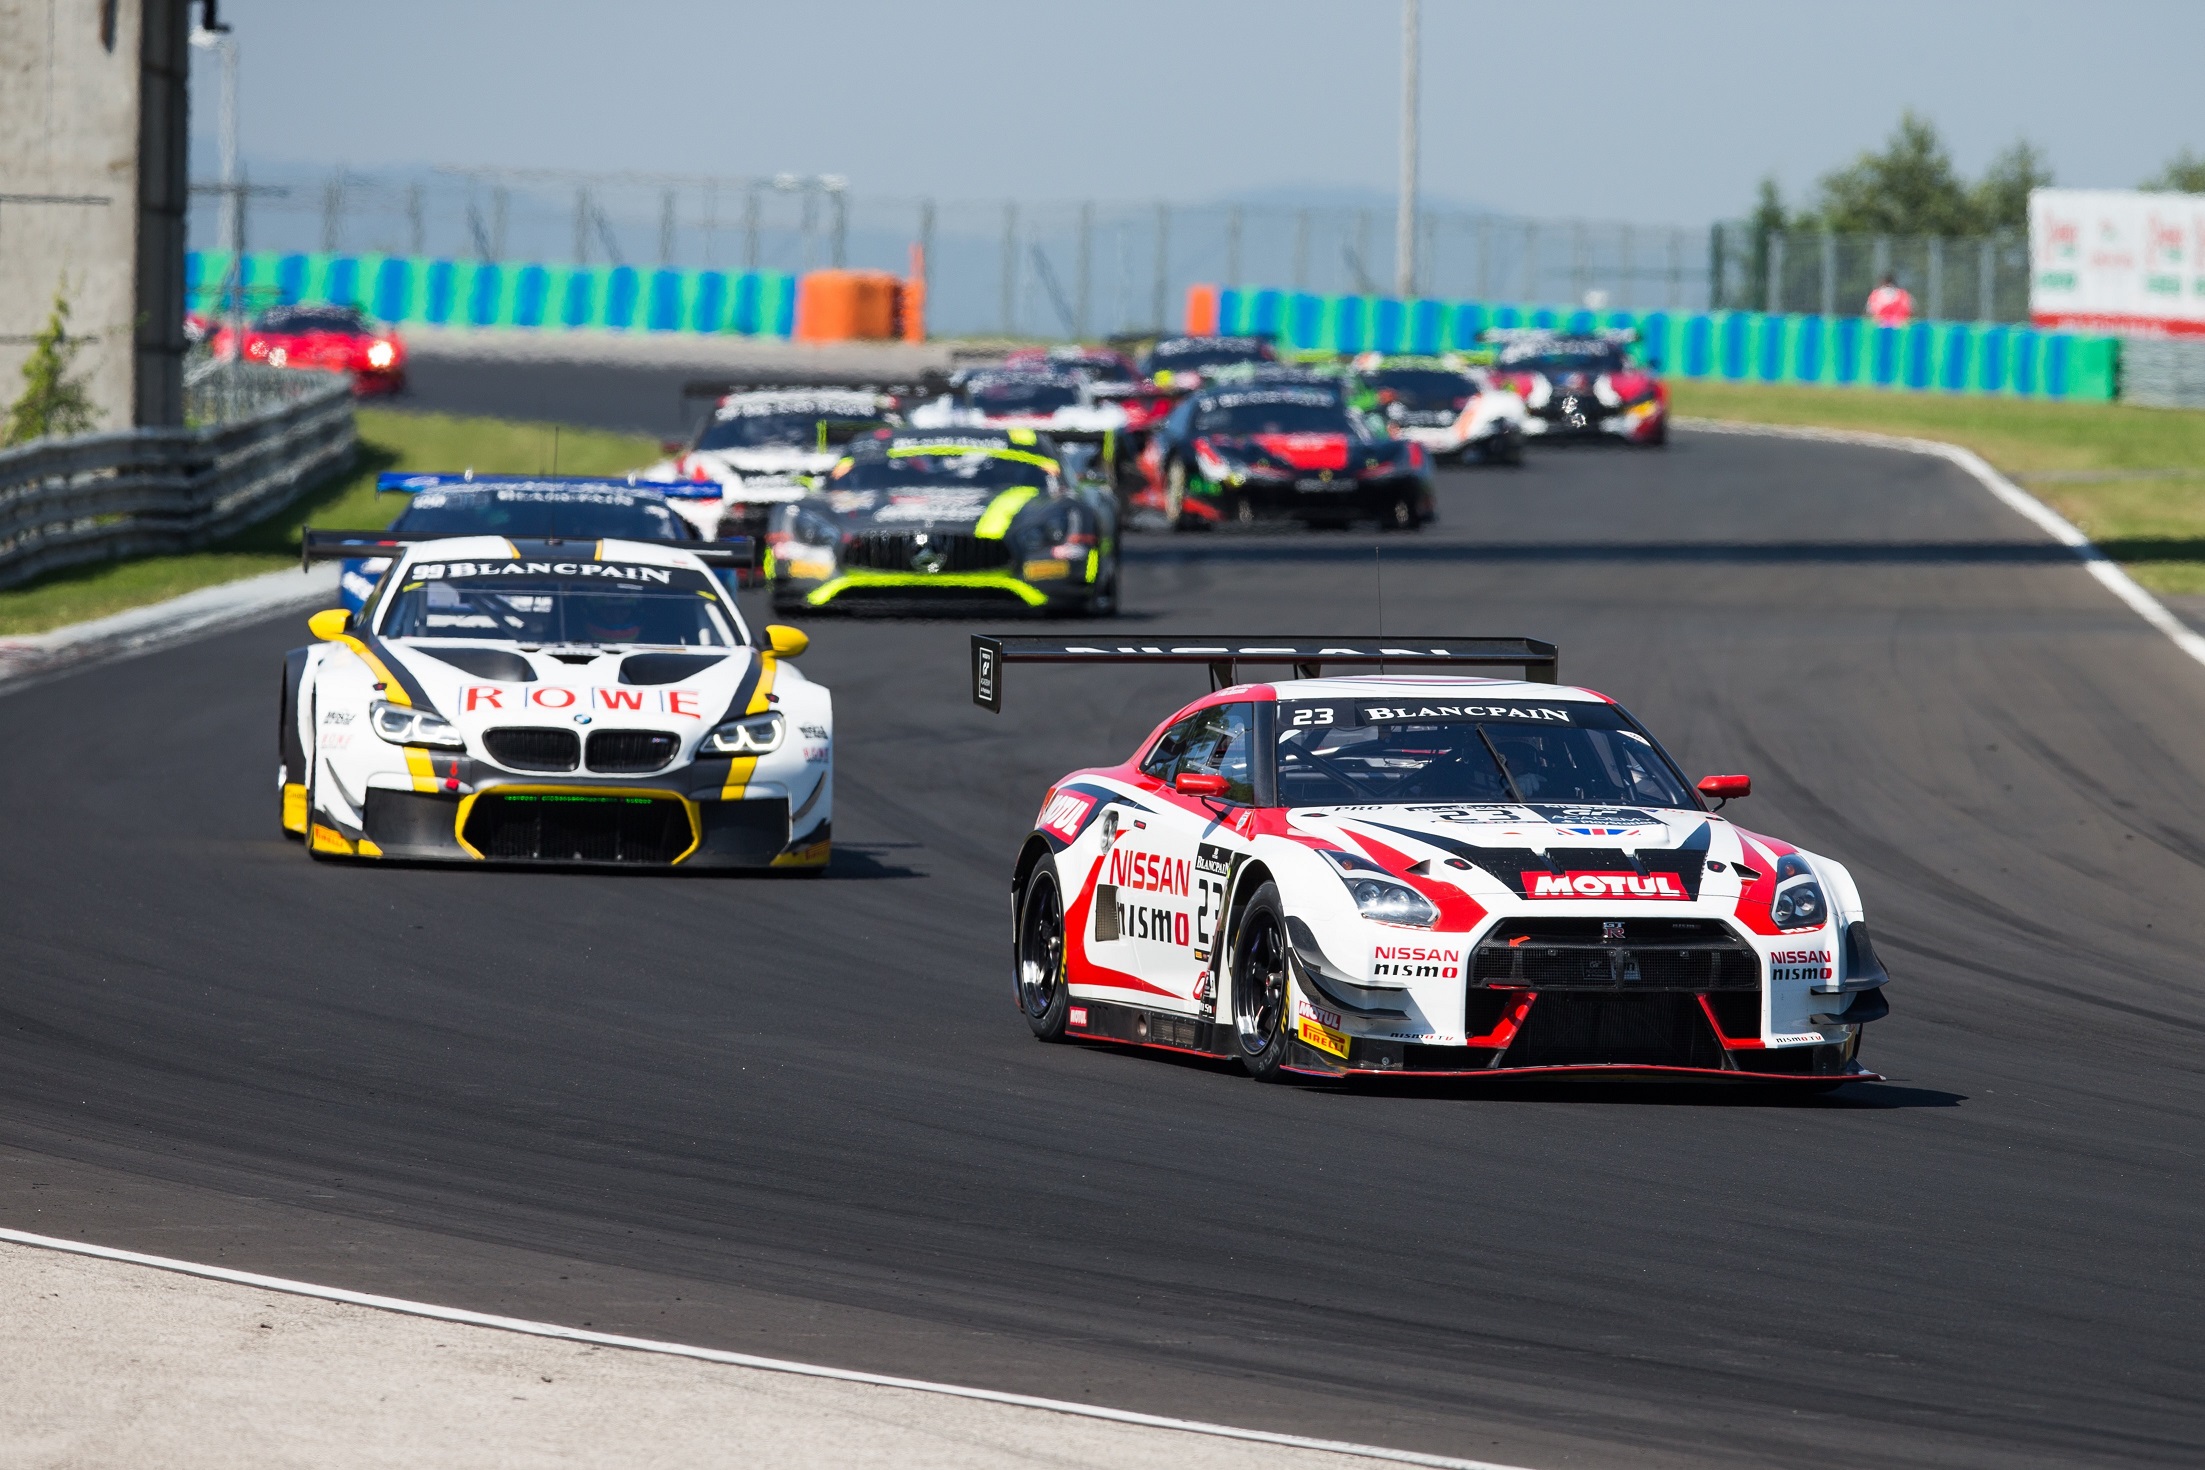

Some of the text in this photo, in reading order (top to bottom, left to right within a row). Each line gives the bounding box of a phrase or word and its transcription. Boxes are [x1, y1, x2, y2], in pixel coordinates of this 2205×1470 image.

[412, 562, 672, 584] 99 BLANCPAIN
[466, 686, 702, 720] ROWE
[1292, 705, 1570, 726] 23 BLANCPAIN
[1433, 810, 1521, 821] 23
[1109, 848, 1191, 897] NISSAN
[1197, 856, 1230, 874] BLANCPAIN
[1535, 875, 1680, 897] MOTUL
[1117, 901, 1190, 947] nismo
[1375, 946, 1459, 962] NISSAN
[1770, 950, 1831, 964] NISSAN
[1374, 963, 1458, 978] nismo
[1772, 967, 1833, 980] nismo
[1300, 1001, 1339, 1029] MOTUL
[1303, 1023, 1346, 1053] PIRELLI
